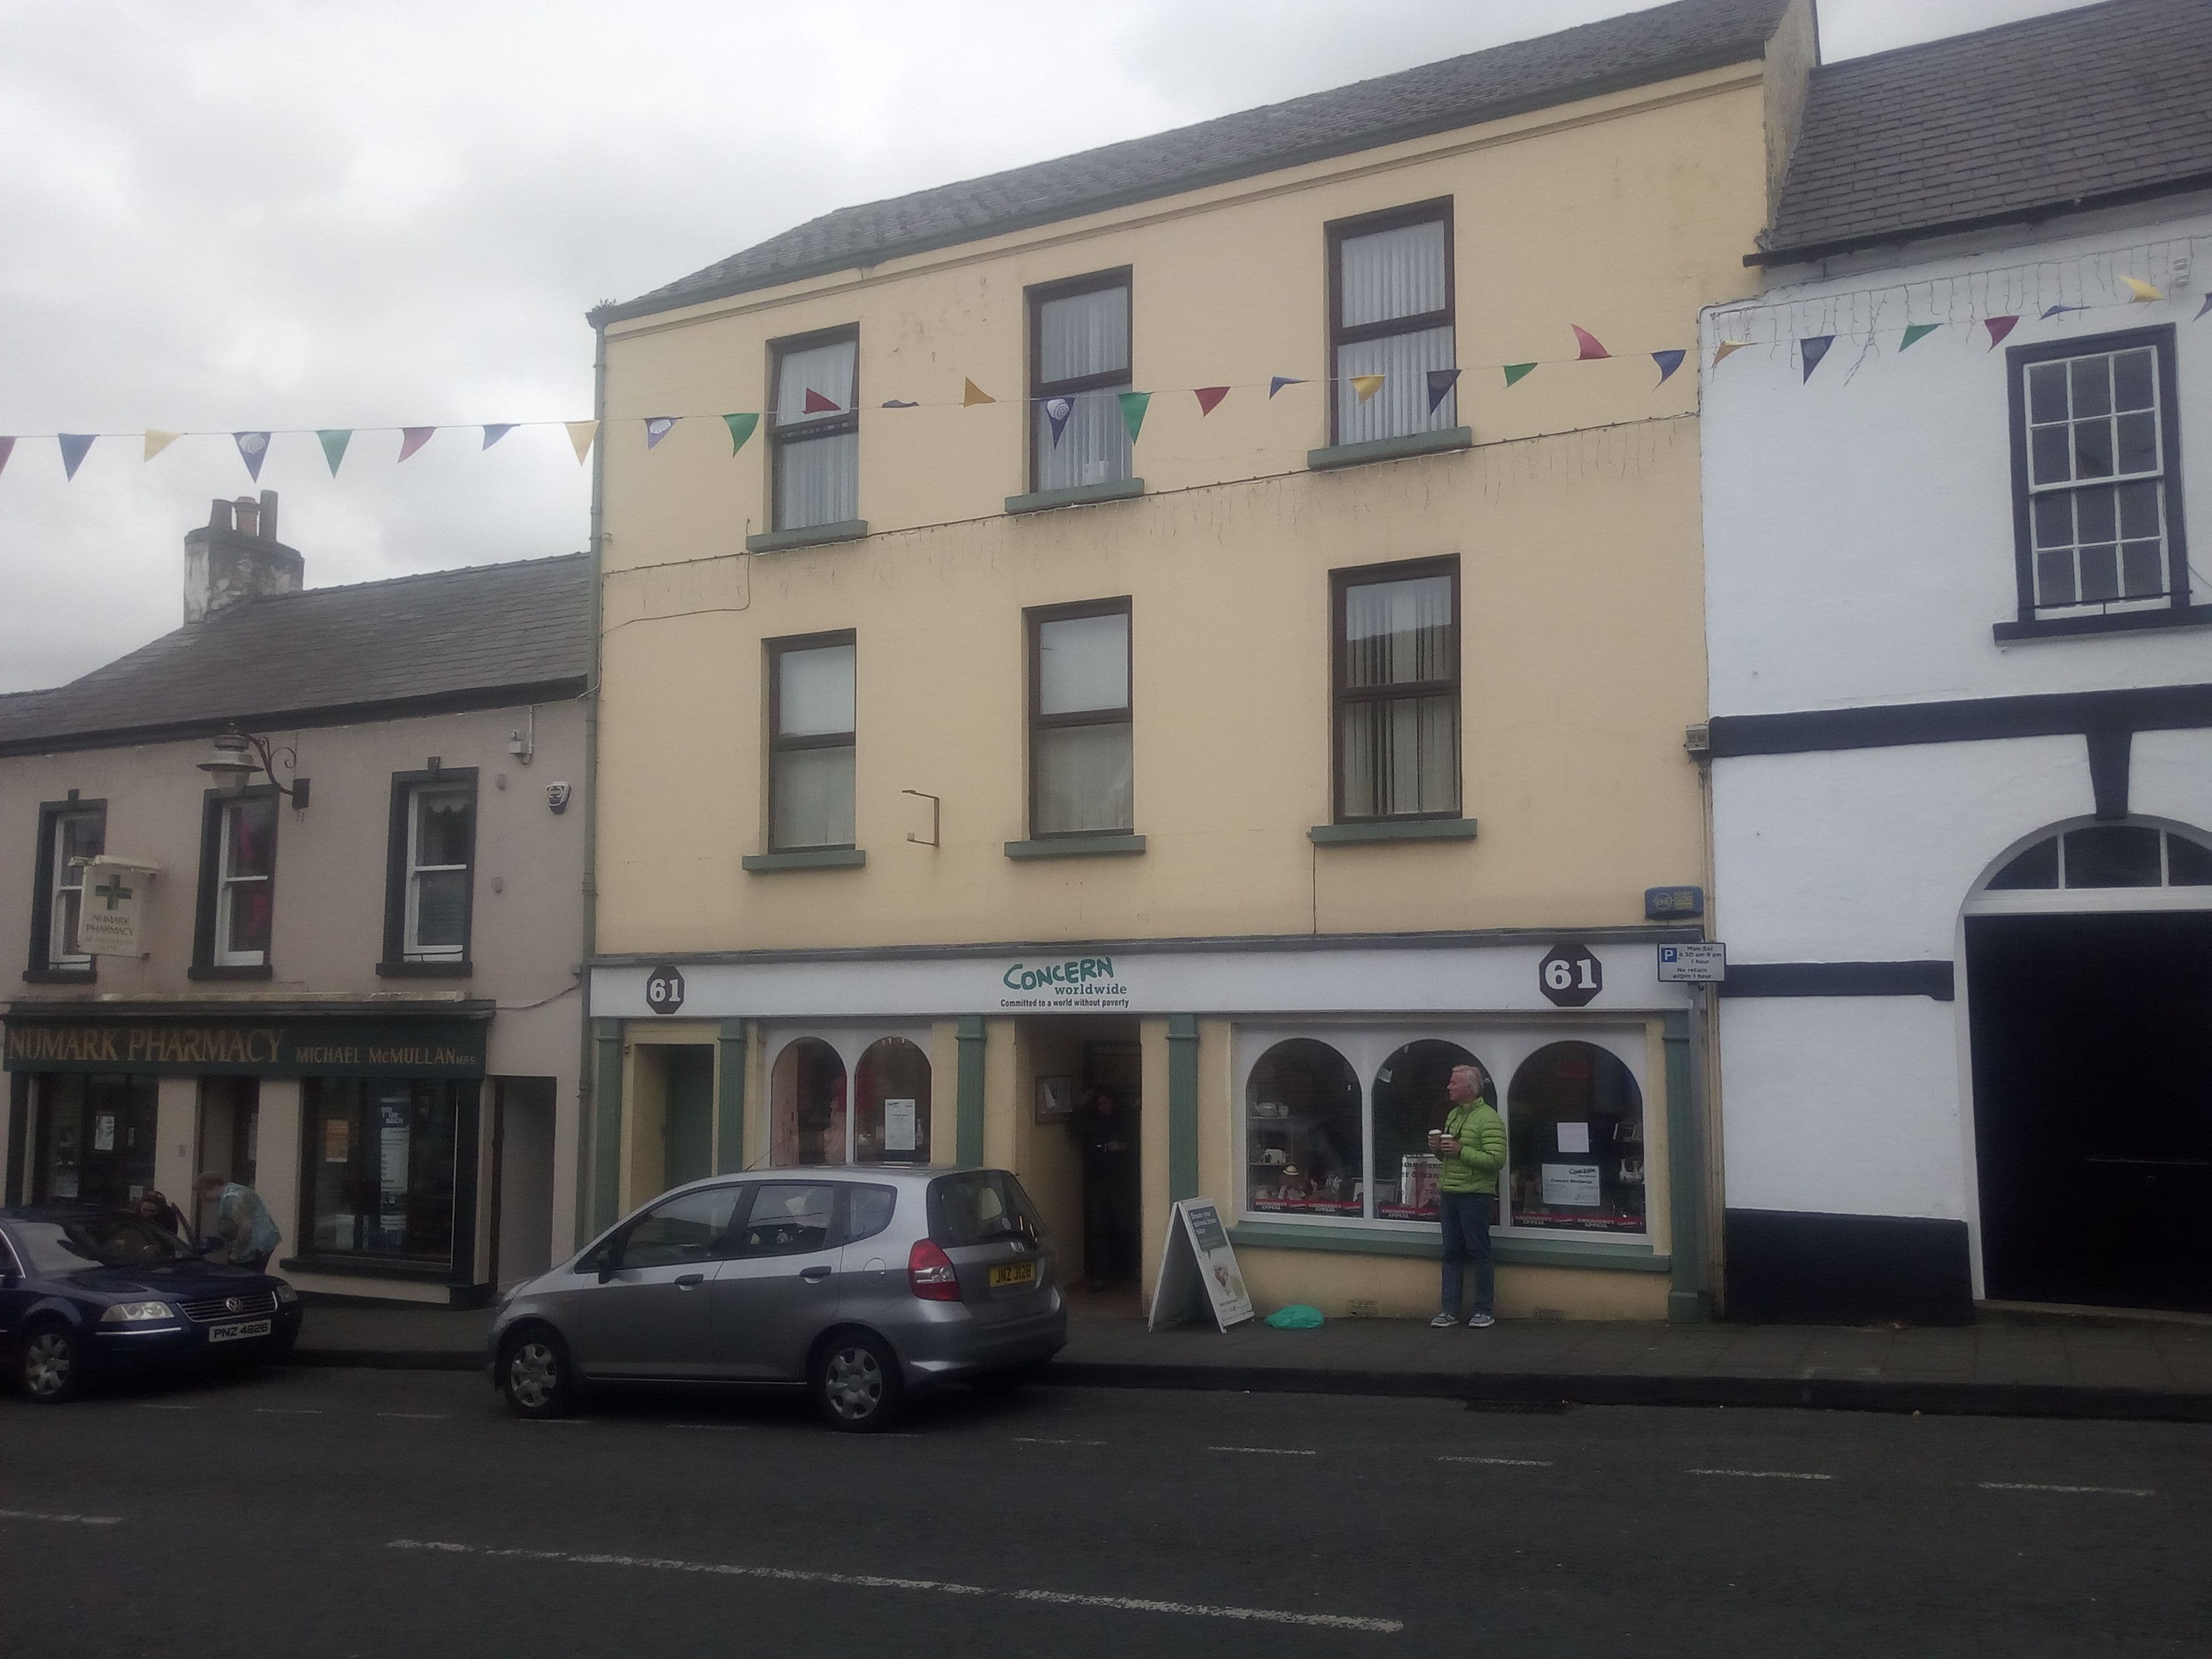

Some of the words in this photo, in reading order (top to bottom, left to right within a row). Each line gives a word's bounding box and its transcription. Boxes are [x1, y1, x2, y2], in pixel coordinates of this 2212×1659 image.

[92, 914, 130, 924] NUMARK
[86, 924, 135, 936] PHARMACY
[1664, 949, 1674, 961] P
[1003, 956, 1114, 991] CONCERN
[1544, 959, 1597, 990] 61
[649, 977, 681, 1002] 61
[1054, 983, 1128, 995] worldwide
[1000, 998, 1037, 1007] Committed
[1039, 999, 1045, 1007] to
[1053, 998, 1073, 1007] world
[1074, 998, 1101, 1007] without
[1102, 998, 1130, 1008] poverty
[8, 1029, 118, 1060] NUMARK
[127, 1029, 284, 1062] PHARMACY
[295, 1046, 361, 1064] MICHAEL
[368, 1047, 456, 1065] McMULLAN
[996, 1267, 1011, 1283] JNZ
[214, 1327, 238, 1338] PNZ
